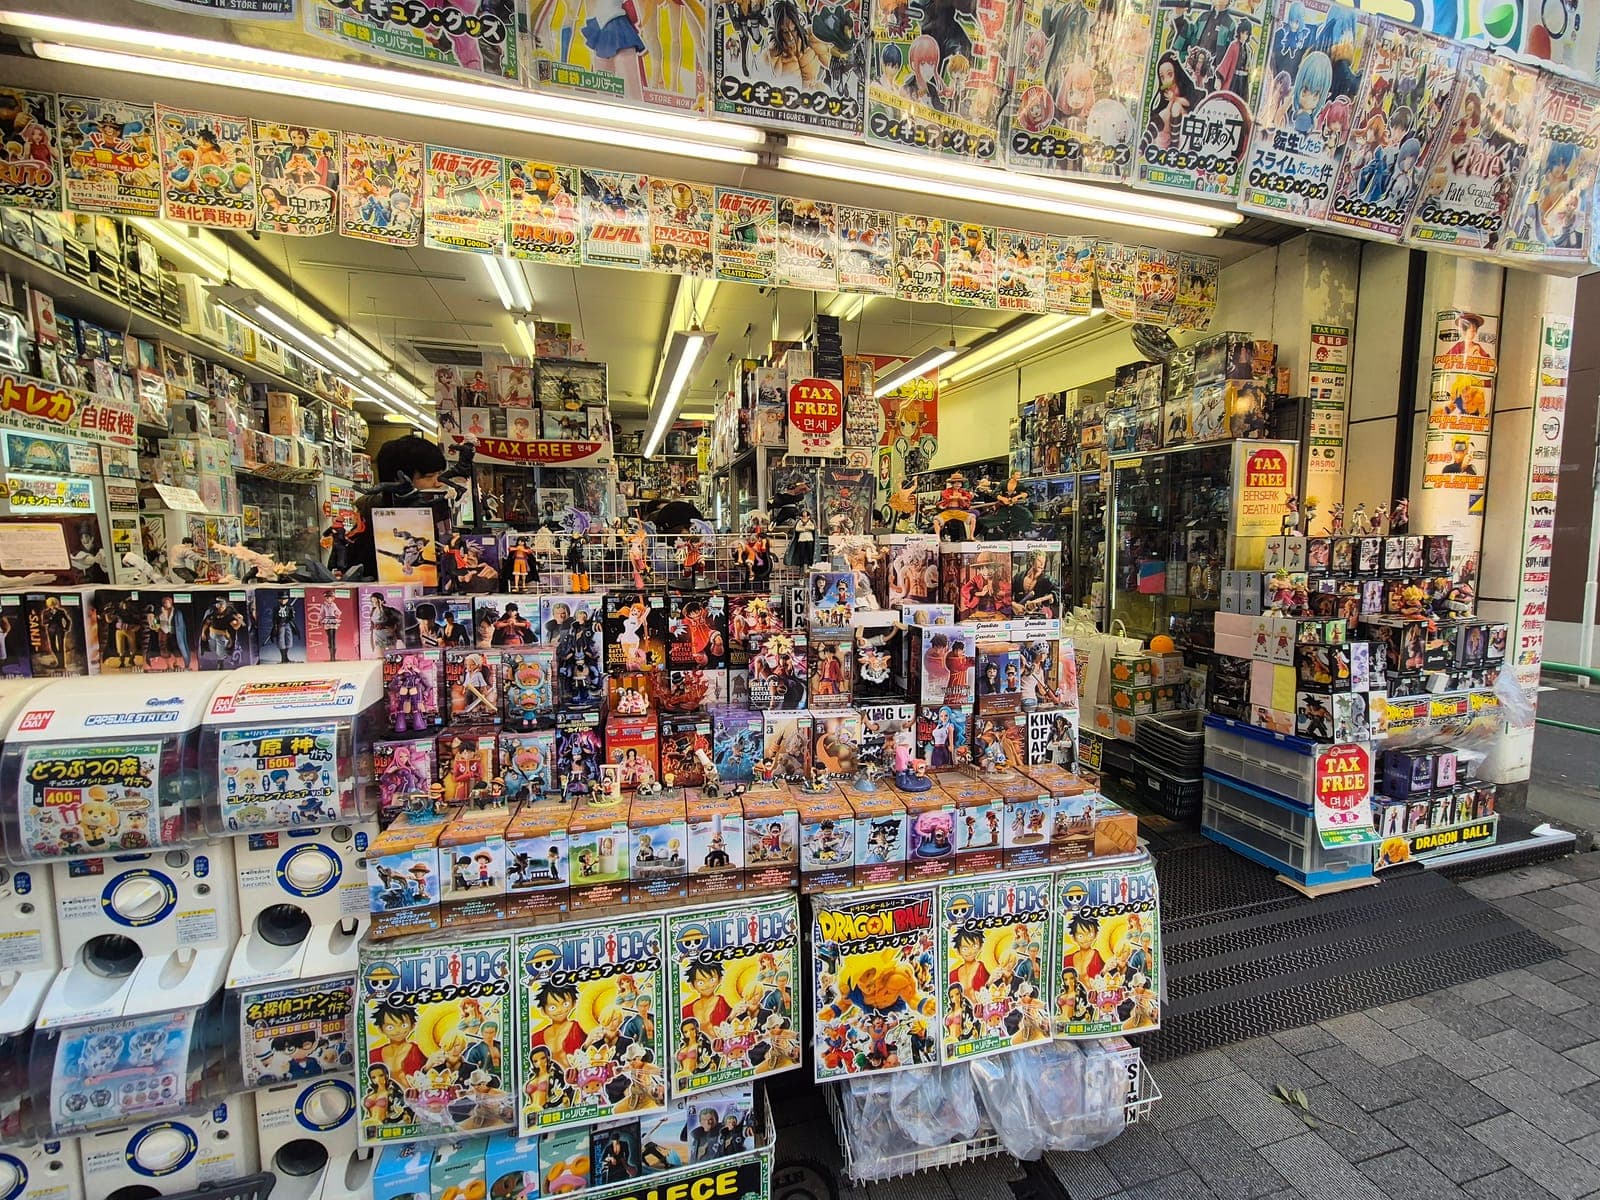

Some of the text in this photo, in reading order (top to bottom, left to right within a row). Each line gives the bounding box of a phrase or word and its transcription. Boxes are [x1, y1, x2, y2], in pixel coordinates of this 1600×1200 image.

[725, 81, 857, 118] フィギュア・グッズ
[875, 118, 995, 157] フィギュア・グッズ
[1181, 116, 1245, 153] 鬼滅の刃
[1273, 131, 1322, 154] 転生したら
[431, 152, 500, 178] 仮面ライダー
[1147, 147, 1238, 176] フィギュア・グッズ
[1254, 150, 1333, 183] スライムだった件
[1252, 171, 1328, 199] フィギュア・グッズ
[719, 193, 772, 213] 仮面ライダー
[1337, 199, 1404, 225] フィギュア・グッズ
[169, 203, 252, 225] 強化買取中!
[1424, 209, 1502, 231] フィギュア・グッズ
[513, 223, 575, 244] NARUTO
[592, 225, 643, 243] ガンダム
[654, 227, 710, 247] ねんどろいど
[1321, 377, 1335, 385] VISA
[0, 376, 73, 422] トレカ
[798, 386, 834, 401] TAX
[794, 401, 839, 416] FREE
[22, 419, 45, 431] Cards
[80, 405, 135, 437] 自販機
[803, 418, 828, 432] 면세
[485, 440, 573, 457] TAX FREE
[1254, 457, 1281, 471] TAX
[1310, 459, 1336, 468] PASMO
[1249, 473, 1285, 487] FREE
[1243, 491, 1279, 502] BERSERK
[1242, 504, 1270, 515] DEATH
[22, 719, 45, 729] DAI
[26, 711, 51, 721] BAN
[84, 710, 179, 727] CAPSULE STATION
[1031, 727, 1047, 740] OF
[258, 736, 314, 757] 原神
[308, 751, 333, 762] ガチャ
[31, 757, 139, 781] どうぶつの森
[1325, 756, 1361, 774] TAX
[123, 777, 152, 788] ガチャ
[1321, 773, 1365, 793] FREE
[226, 789, 309, 805] コレクションフィギュア
[1415, 824, 1490, 850] DRAGON BALL
[1061, 874, 1155, 909] ONE PIECE
[946, 885, 1049, 921] ONE PIECE
[1082, 901, 1155, 918] フィギュア・グッズ
[818, 898, 932, 943] DRAGON BALL
[967, 910, 1048, 930] フィギュア・グッズ
[676, 906, 797, 957] ONE PIECE
[525, 928, 660, 981] ONE PIECE
[700, 936, 797, 962] フィギュア・グッズ
[840, 936, 918, 955] フィギュア・グッズ
[364, 949, 508, 998] ONE PIECE
[553, 958, 661, 986] フィギュア・グッズ
[388, 981, 510, 1007] フィギュア・グッズ
[249, 995, 330, 1020] 名探偵コナン
